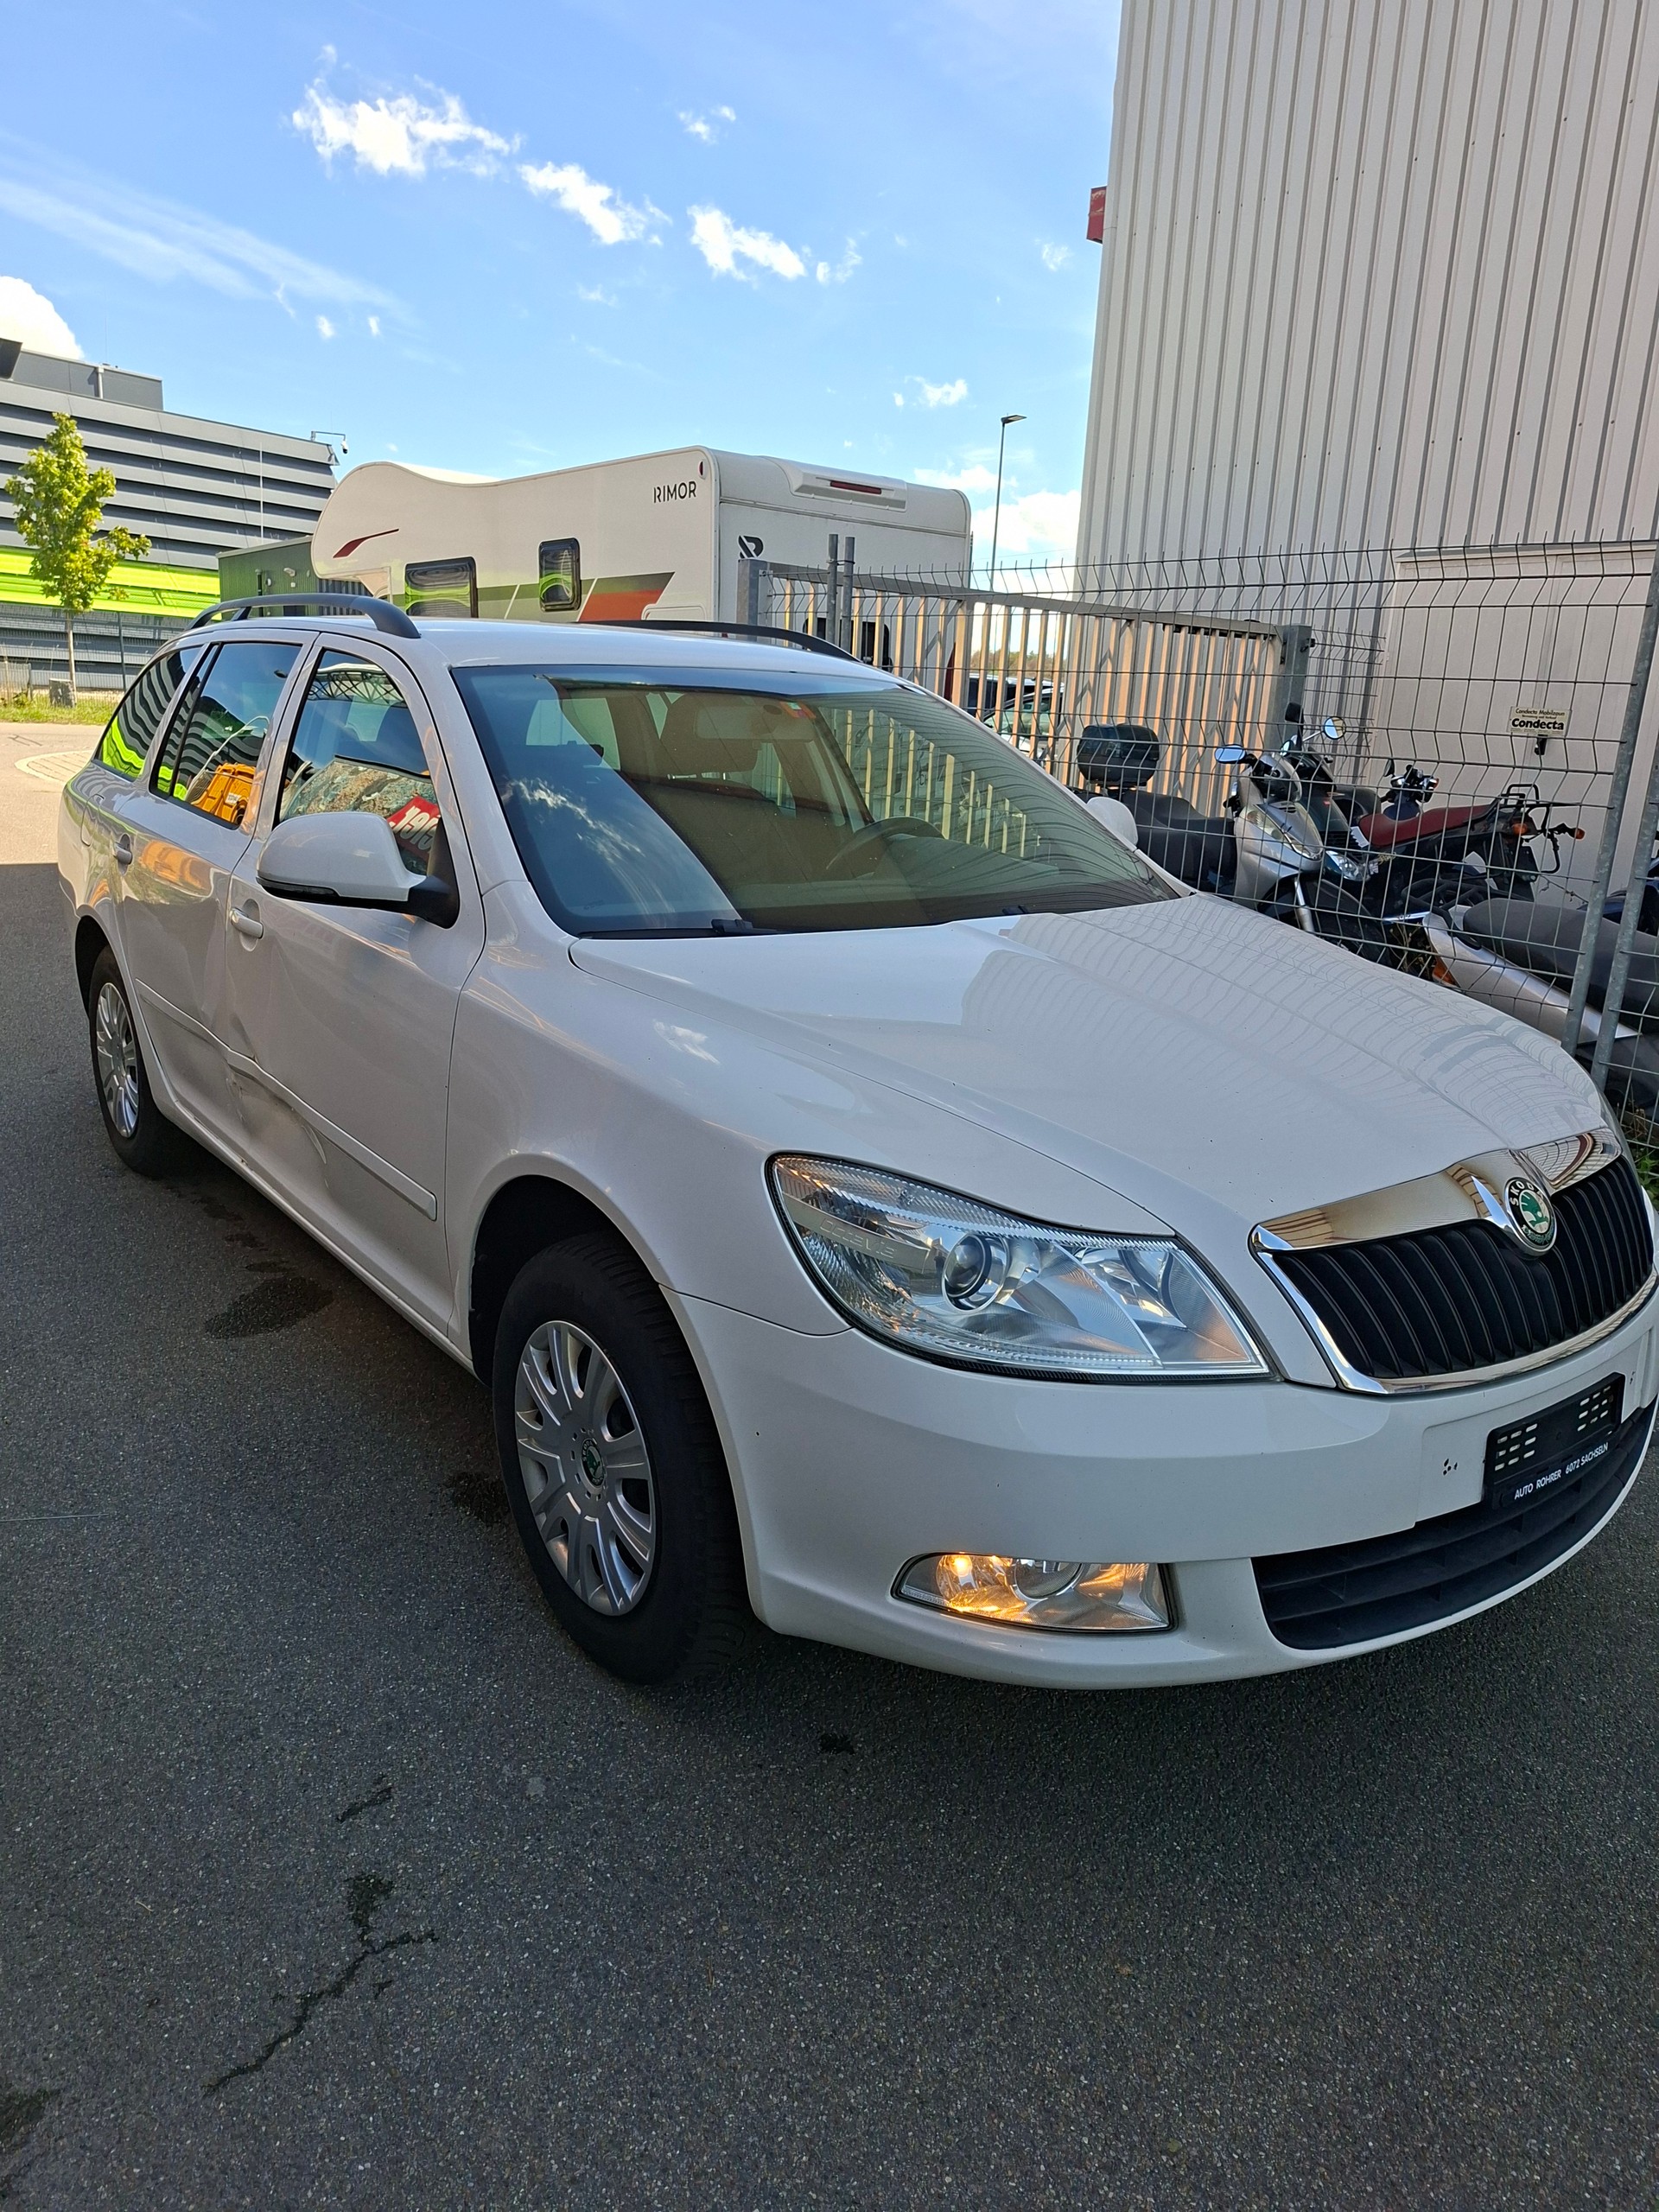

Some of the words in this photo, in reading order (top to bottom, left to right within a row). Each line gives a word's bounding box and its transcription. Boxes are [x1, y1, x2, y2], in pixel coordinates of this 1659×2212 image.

[653, 480, 696, 503] RIMOR
[1511, 718, 1564, 730] Condecta
[1514, 1483, 1534, 1500] AUTO
[1535, 1469, 1561, 1489] ROHRER
[1565, 1459, 1580, 1474] 6072
[1580, 1442, 1609, 1466] SACHSELN
